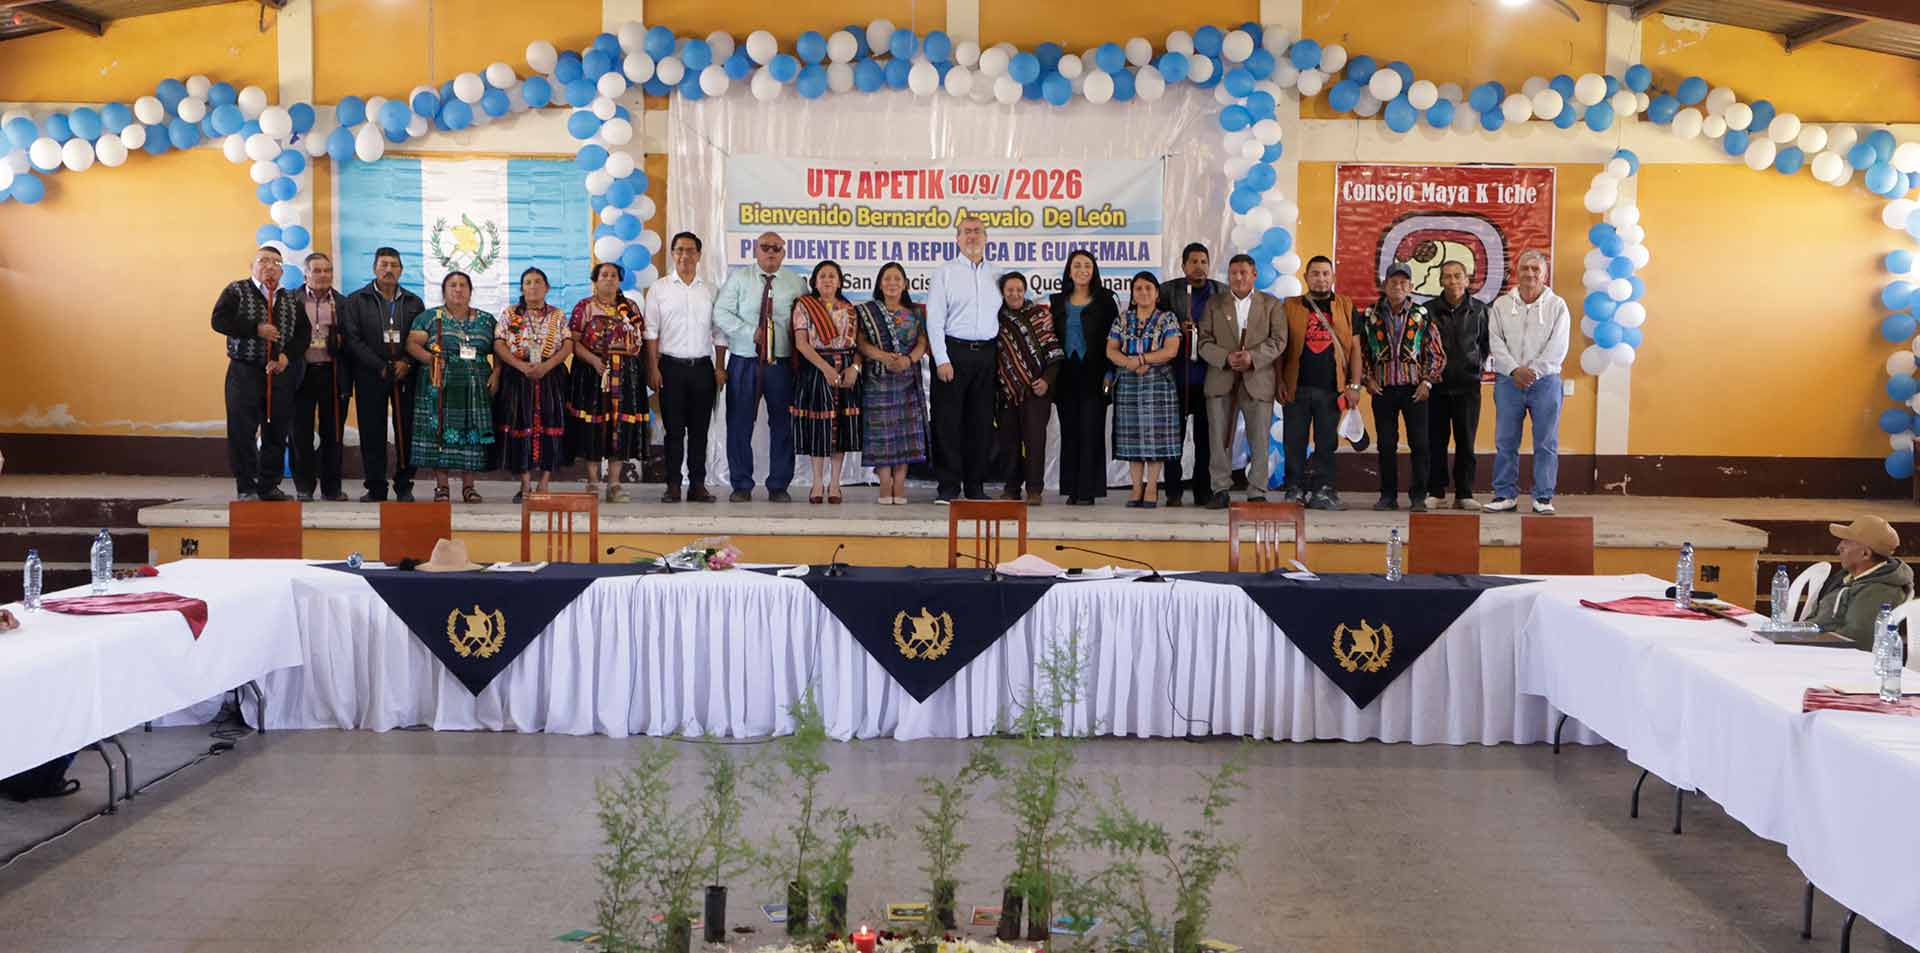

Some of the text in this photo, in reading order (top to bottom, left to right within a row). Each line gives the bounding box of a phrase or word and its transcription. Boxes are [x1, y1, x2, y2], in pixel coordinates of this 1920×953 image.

[807, 168, 852, 198] UTZ
[857, 169, 944, 199] APETIK
[1343, 181, 1415, 204] Consejo
[1421, 183, 1469, 205] Maya
[740, 203, 853, 226] Bienvenido
[856, 206, 951, 227] Bernardo
[1043, 206, 1072, 227] De
[1075, 203, 1126, 227] León
[854, 241, 877, 260] DE
[882, 241, 903, 261] LA
[1014, 242, 1037, 261] DE
[843, 274, 872, 290] San
